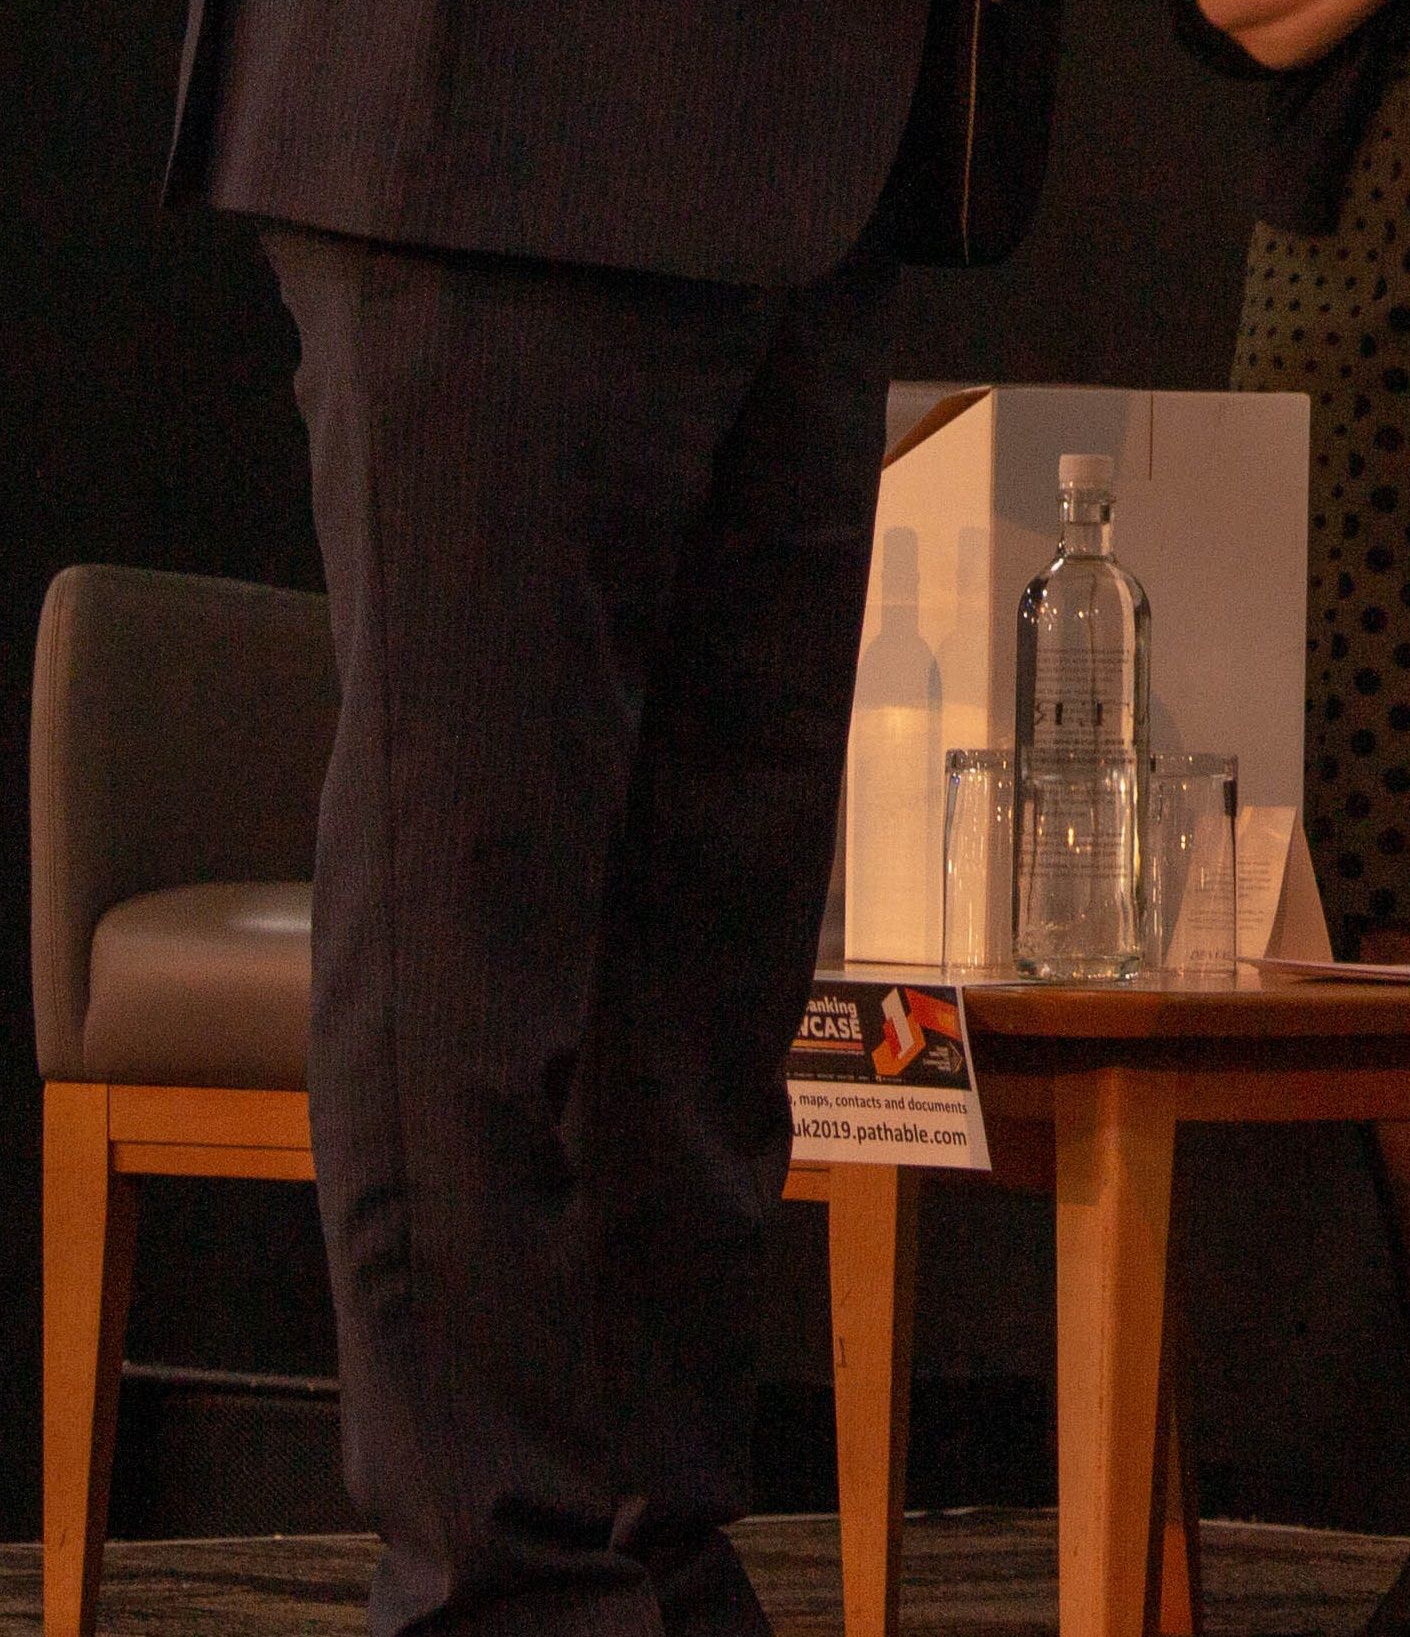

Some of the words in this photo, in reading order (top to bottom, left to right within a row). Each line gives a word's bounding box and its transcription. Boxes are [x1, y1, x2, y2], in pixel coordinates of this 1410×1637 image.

[806, 996, 858, 1019] anking
[800, 1094, 833, 1113] maps,
[835, 1095, 882, 1110] contacts
[884, 1097, 905, 1110] and
[908, 1097, 968, 1114] documents
